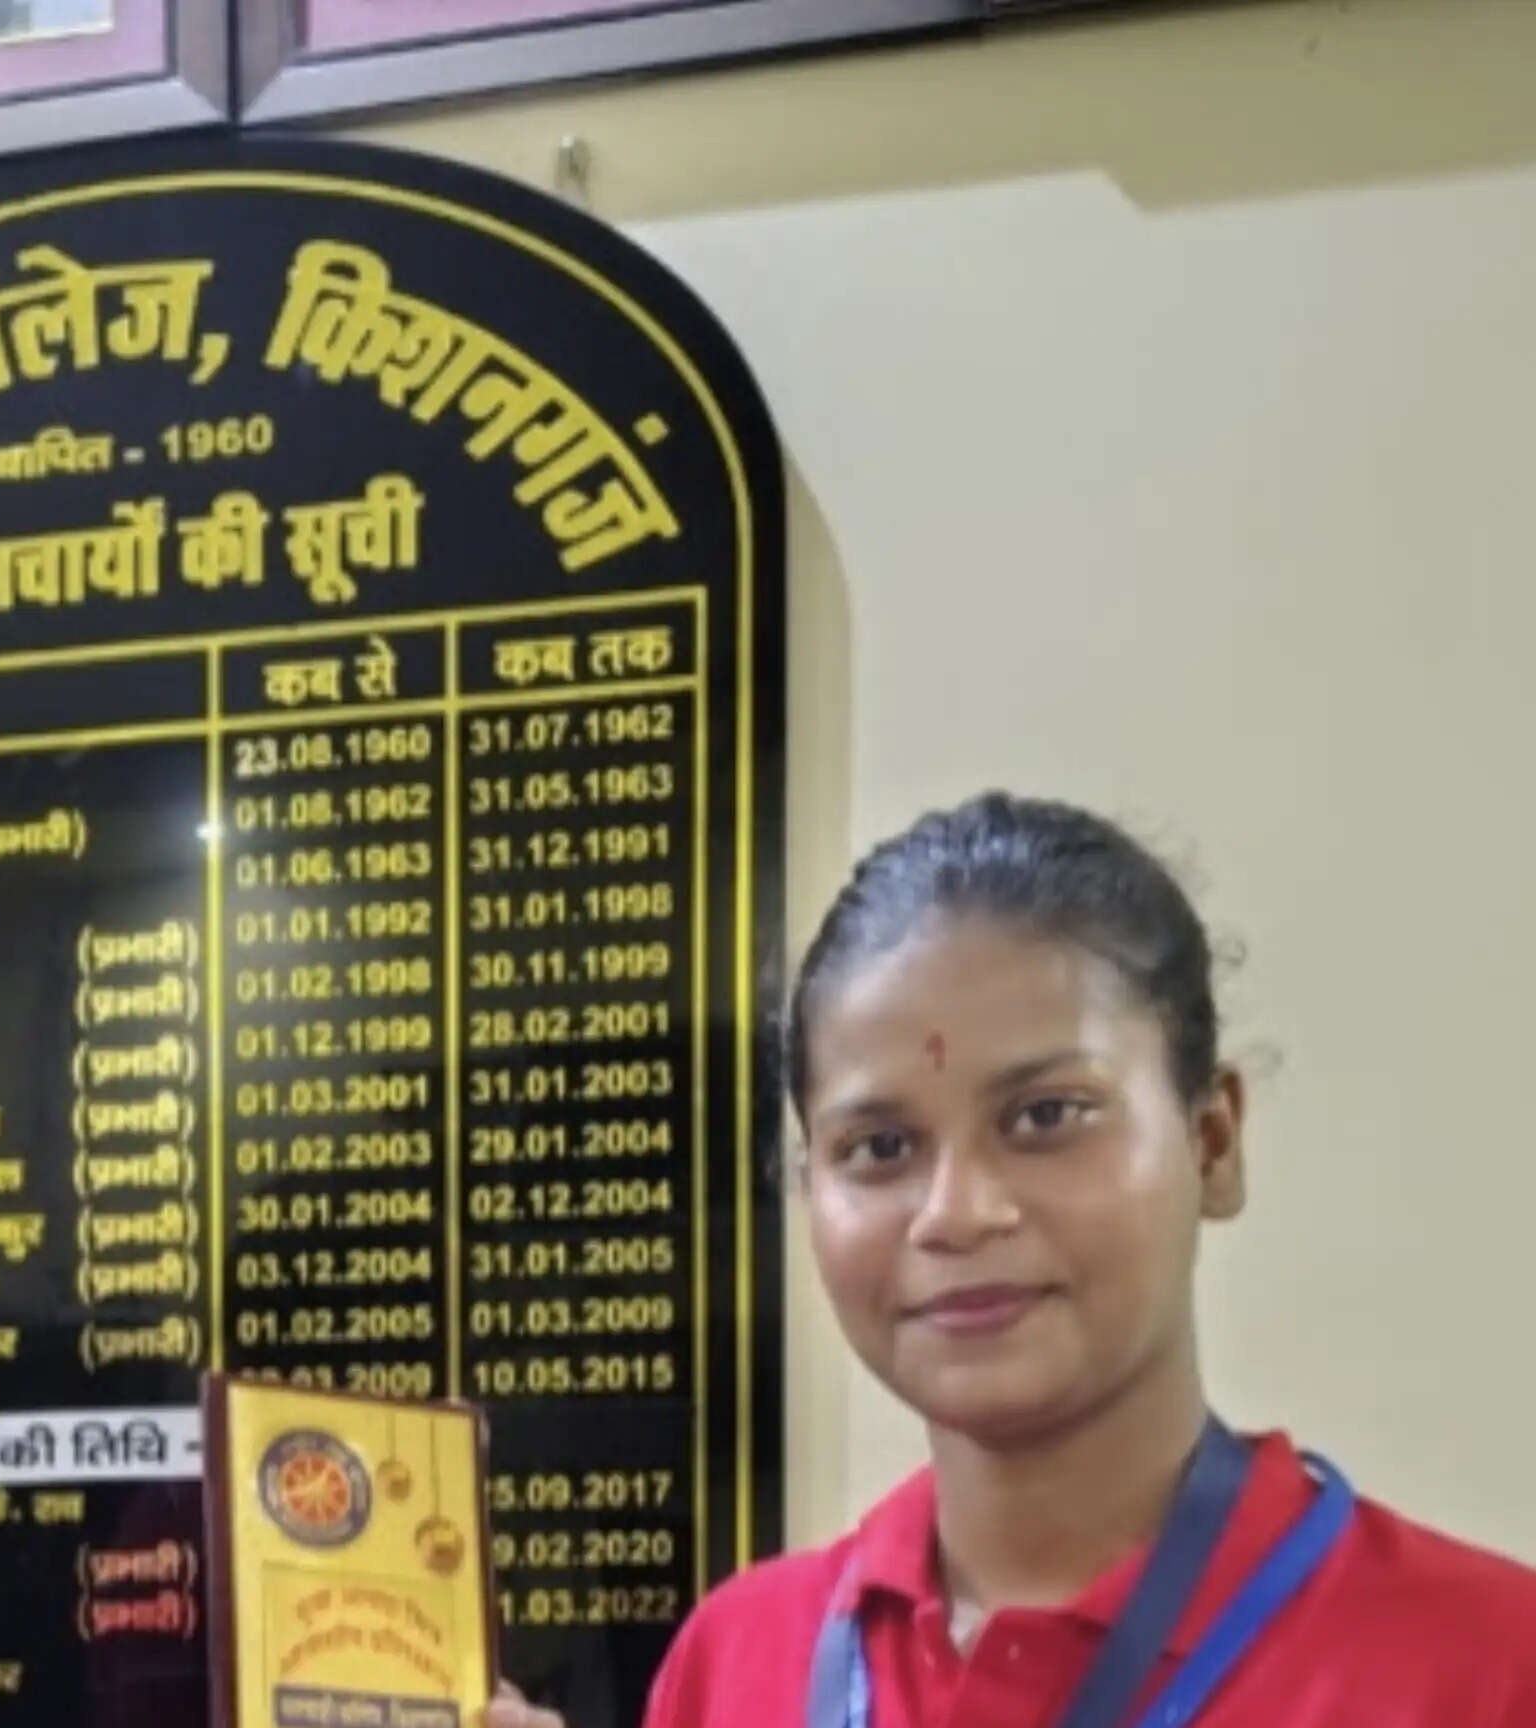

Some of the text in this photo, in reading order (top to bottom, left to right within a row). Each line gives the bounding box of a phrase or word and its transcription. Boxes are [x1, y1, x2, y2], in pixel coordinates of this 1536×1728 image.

[264, 240, 679, 572] किशनगंज
[162, 415, 273, 461] 1960
[178, 491, 270, 588] की
[284, 475, 424, 603] सूची
[262, 635, 396, 704] कब से
[495, 626, 672, 682] कब तक
[470, 704, 674, 754] 31.07.1962
[235, 785, 431, 829] 01.08.1962
[470, 765, 674, 814] 31.05.1963
[236, 843, 431, 887] 01.06.1963
[470, 825, 670, 871] 31.12.1991
[236, 901, 431, 944] 01.01.1992
[470, 884, 673, 932] 31.01.1998
[236, 960, 431, 1002] 01.02.1998
[470, 945, 670, 988] 30.11.1999
[236, 1018, 431, 1060] 01.12.1999
[470, 1003, 670, 1048] 28.02.2001
[236, 1076, 428, 1116] 01.03.2001
[470, 1063, 673, 1103] 31.01.2003
[236, 1134, 431, 1173] 01.02.2003
[470, 1122, 673, 1163] 29.01.2004
[236, 1193, 431, 1231] 30.01.2004
[470, 1181, 673, 1221] 02.12.2004
[236, 1249, 431, 1287] 03.12.2004
[470, 1238, 674, 1279] 31.01.2005
[236, 1306, 432, 1343] 01.02.2005
[470, 1299, 673, 1335] 01.03.2009
[473, 1355, 674, 1395] 10.05.2015
[72, 1423, 169, 1467] तिथि
[485, 1471, 674, 1513] 5.09.2017
[493, 1531, 673, 1568] 9.02.2020
[499, 1586, 676, 1626] 1.03.2022
